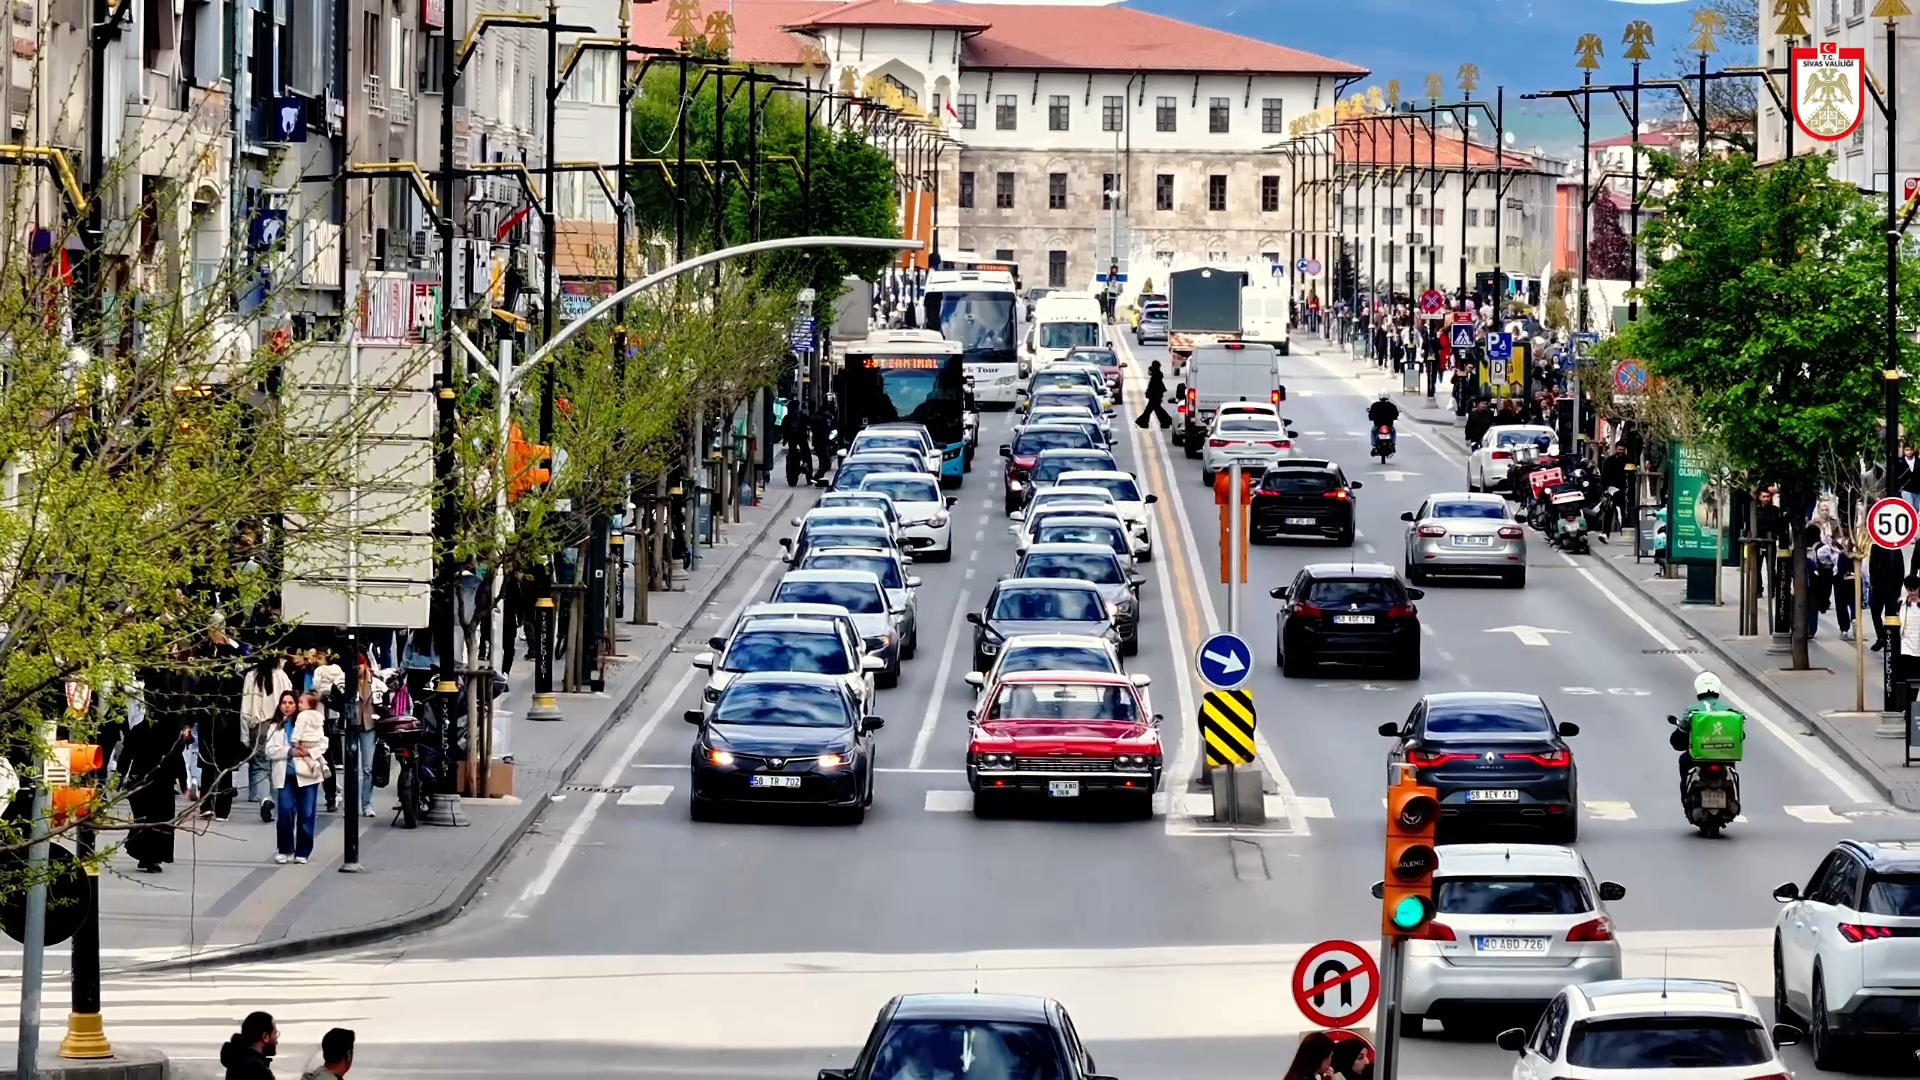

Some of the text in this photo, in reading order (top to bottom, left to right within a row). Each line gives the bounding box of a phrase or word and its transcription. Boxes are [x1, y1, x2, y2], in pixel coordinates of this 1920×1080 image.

[1878, 513, 1910, 536] 50
[785, 777, 800, 786] 702
[1484, 939, 1543, 950] 40 ABD 726
